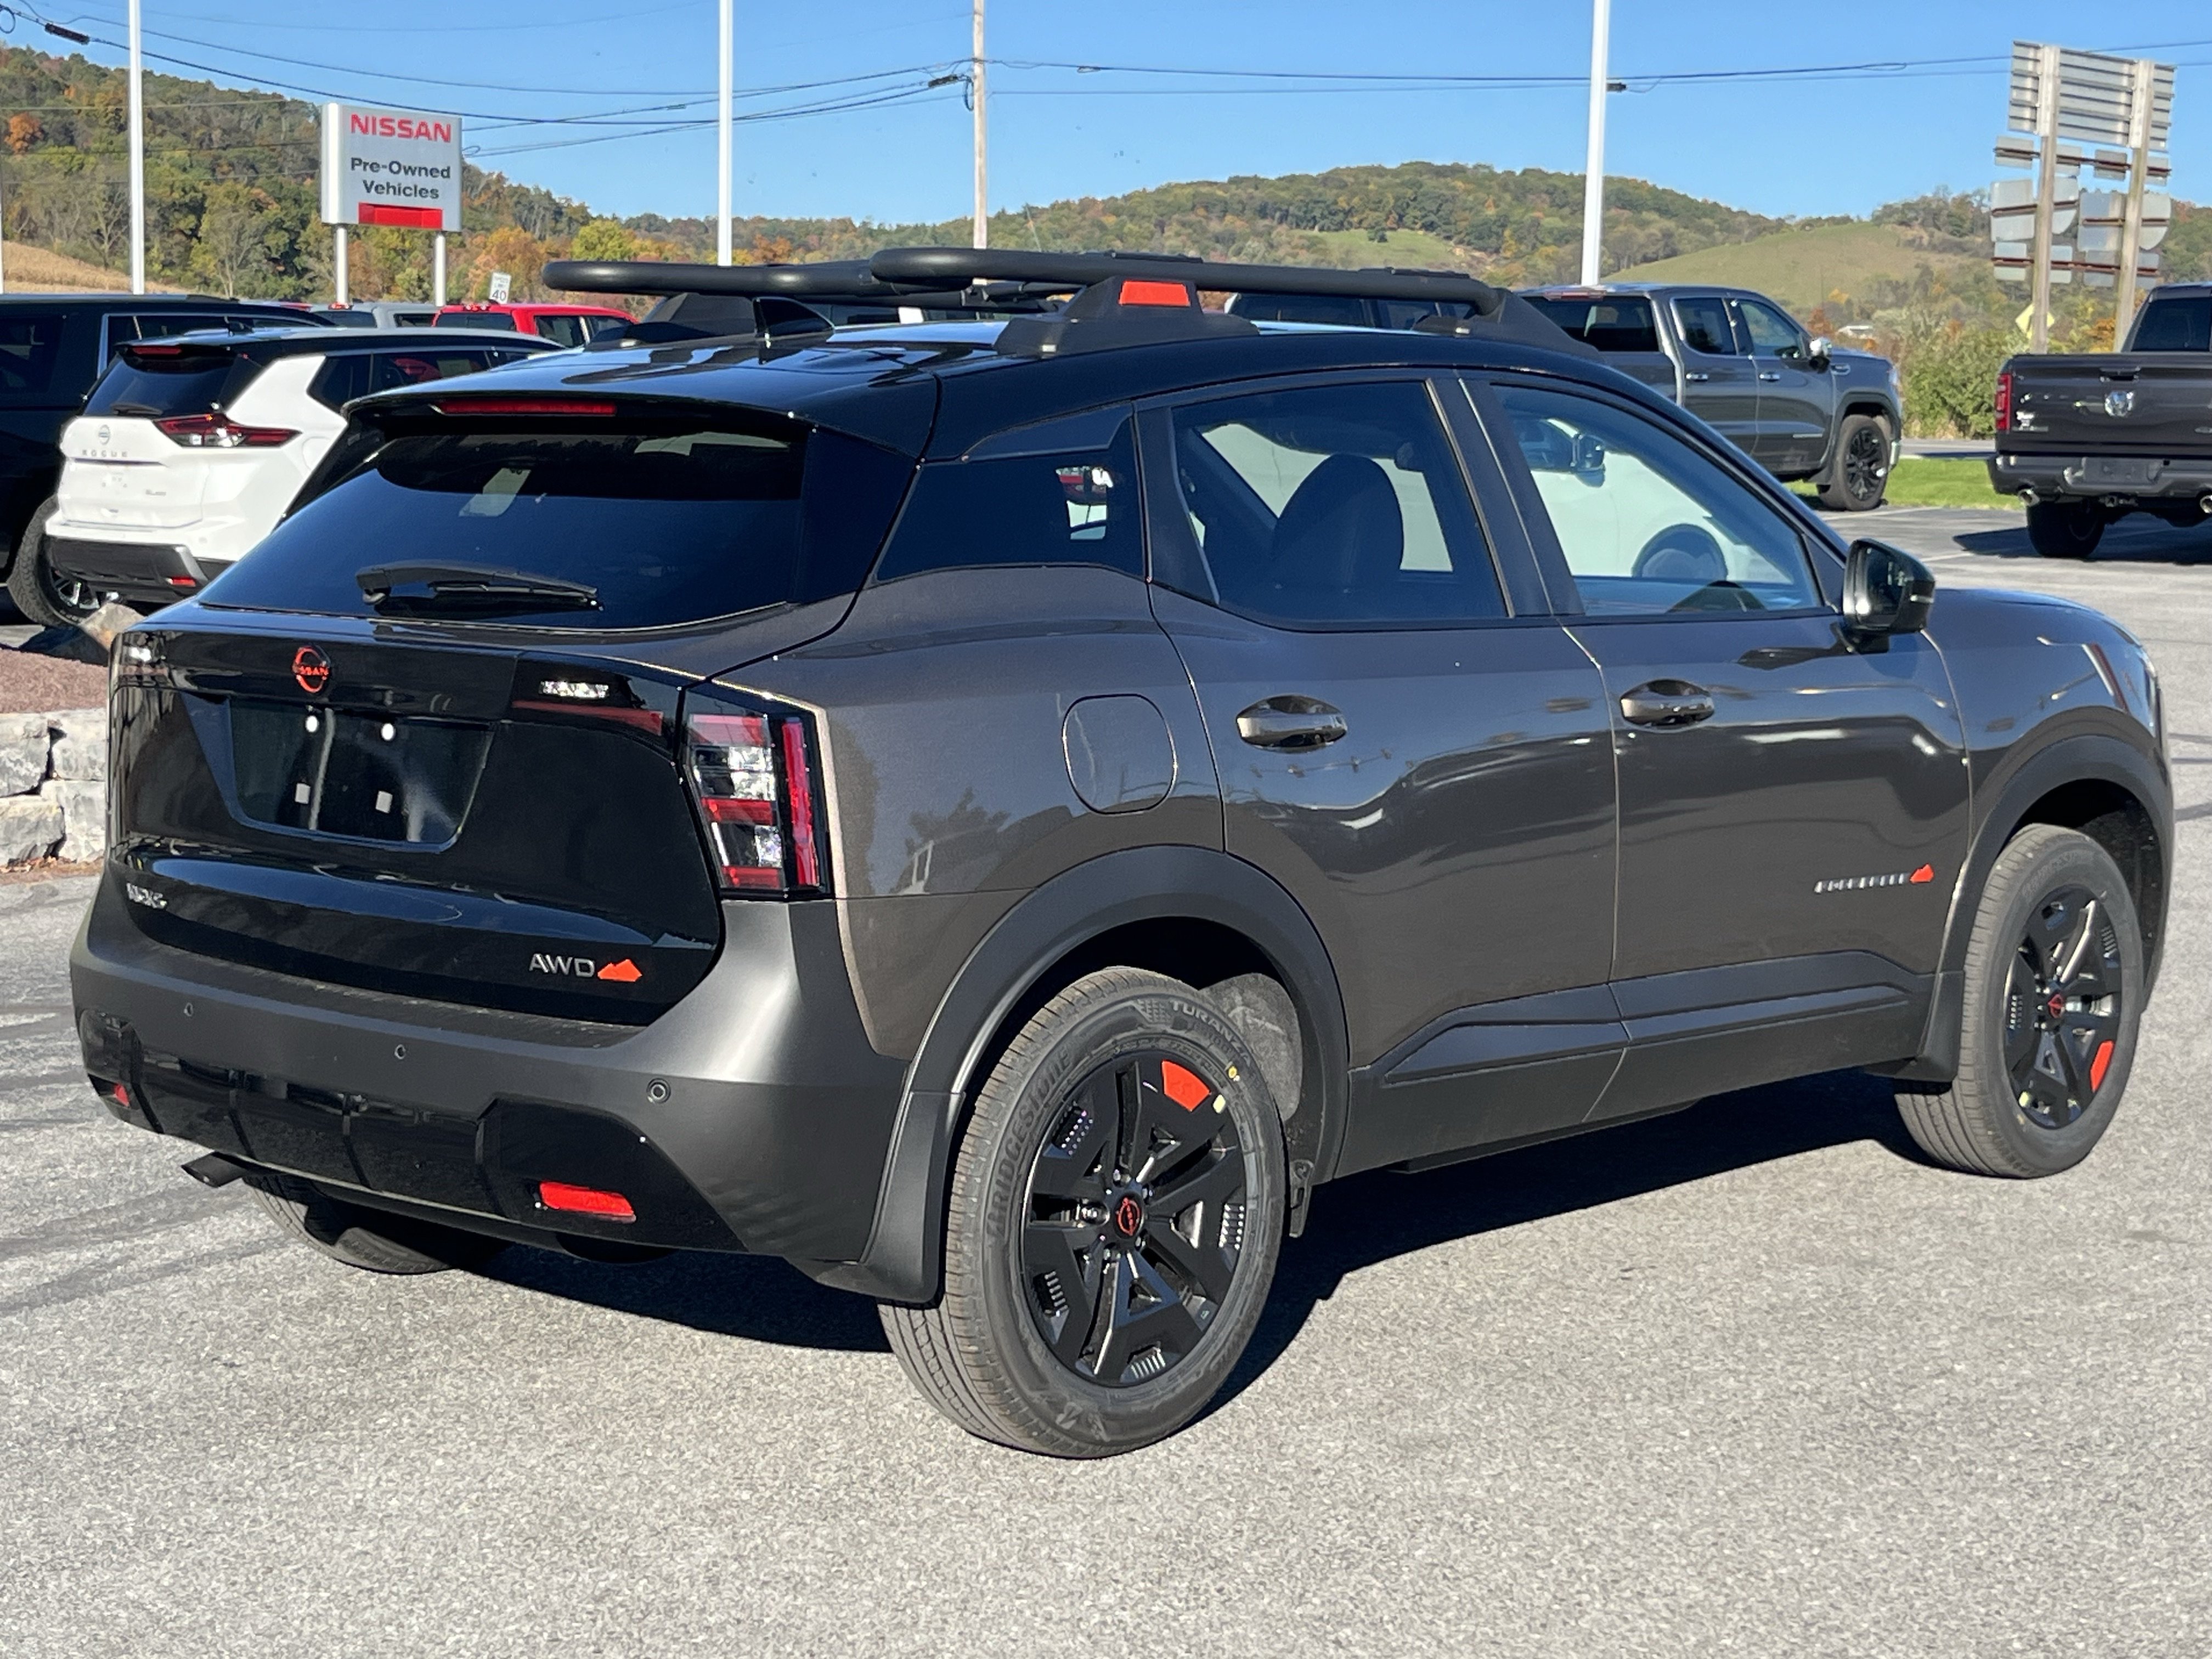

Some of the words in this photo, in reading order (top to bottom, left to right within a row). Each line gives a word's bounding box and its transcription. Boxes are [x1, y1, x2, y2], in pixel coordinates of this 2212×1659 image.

[351, 114, 451, 143] NISSAN
[351, 157, 451, 179] Pre-Owned
[363, 179, 439, 199] Vehicles
[492, 289, 507, 301] 40
[82, 449, 128, 458] ROGUE
[529, 953, 595, 978] AWD
[1169, 998, 1251, 1068] TURANZA
